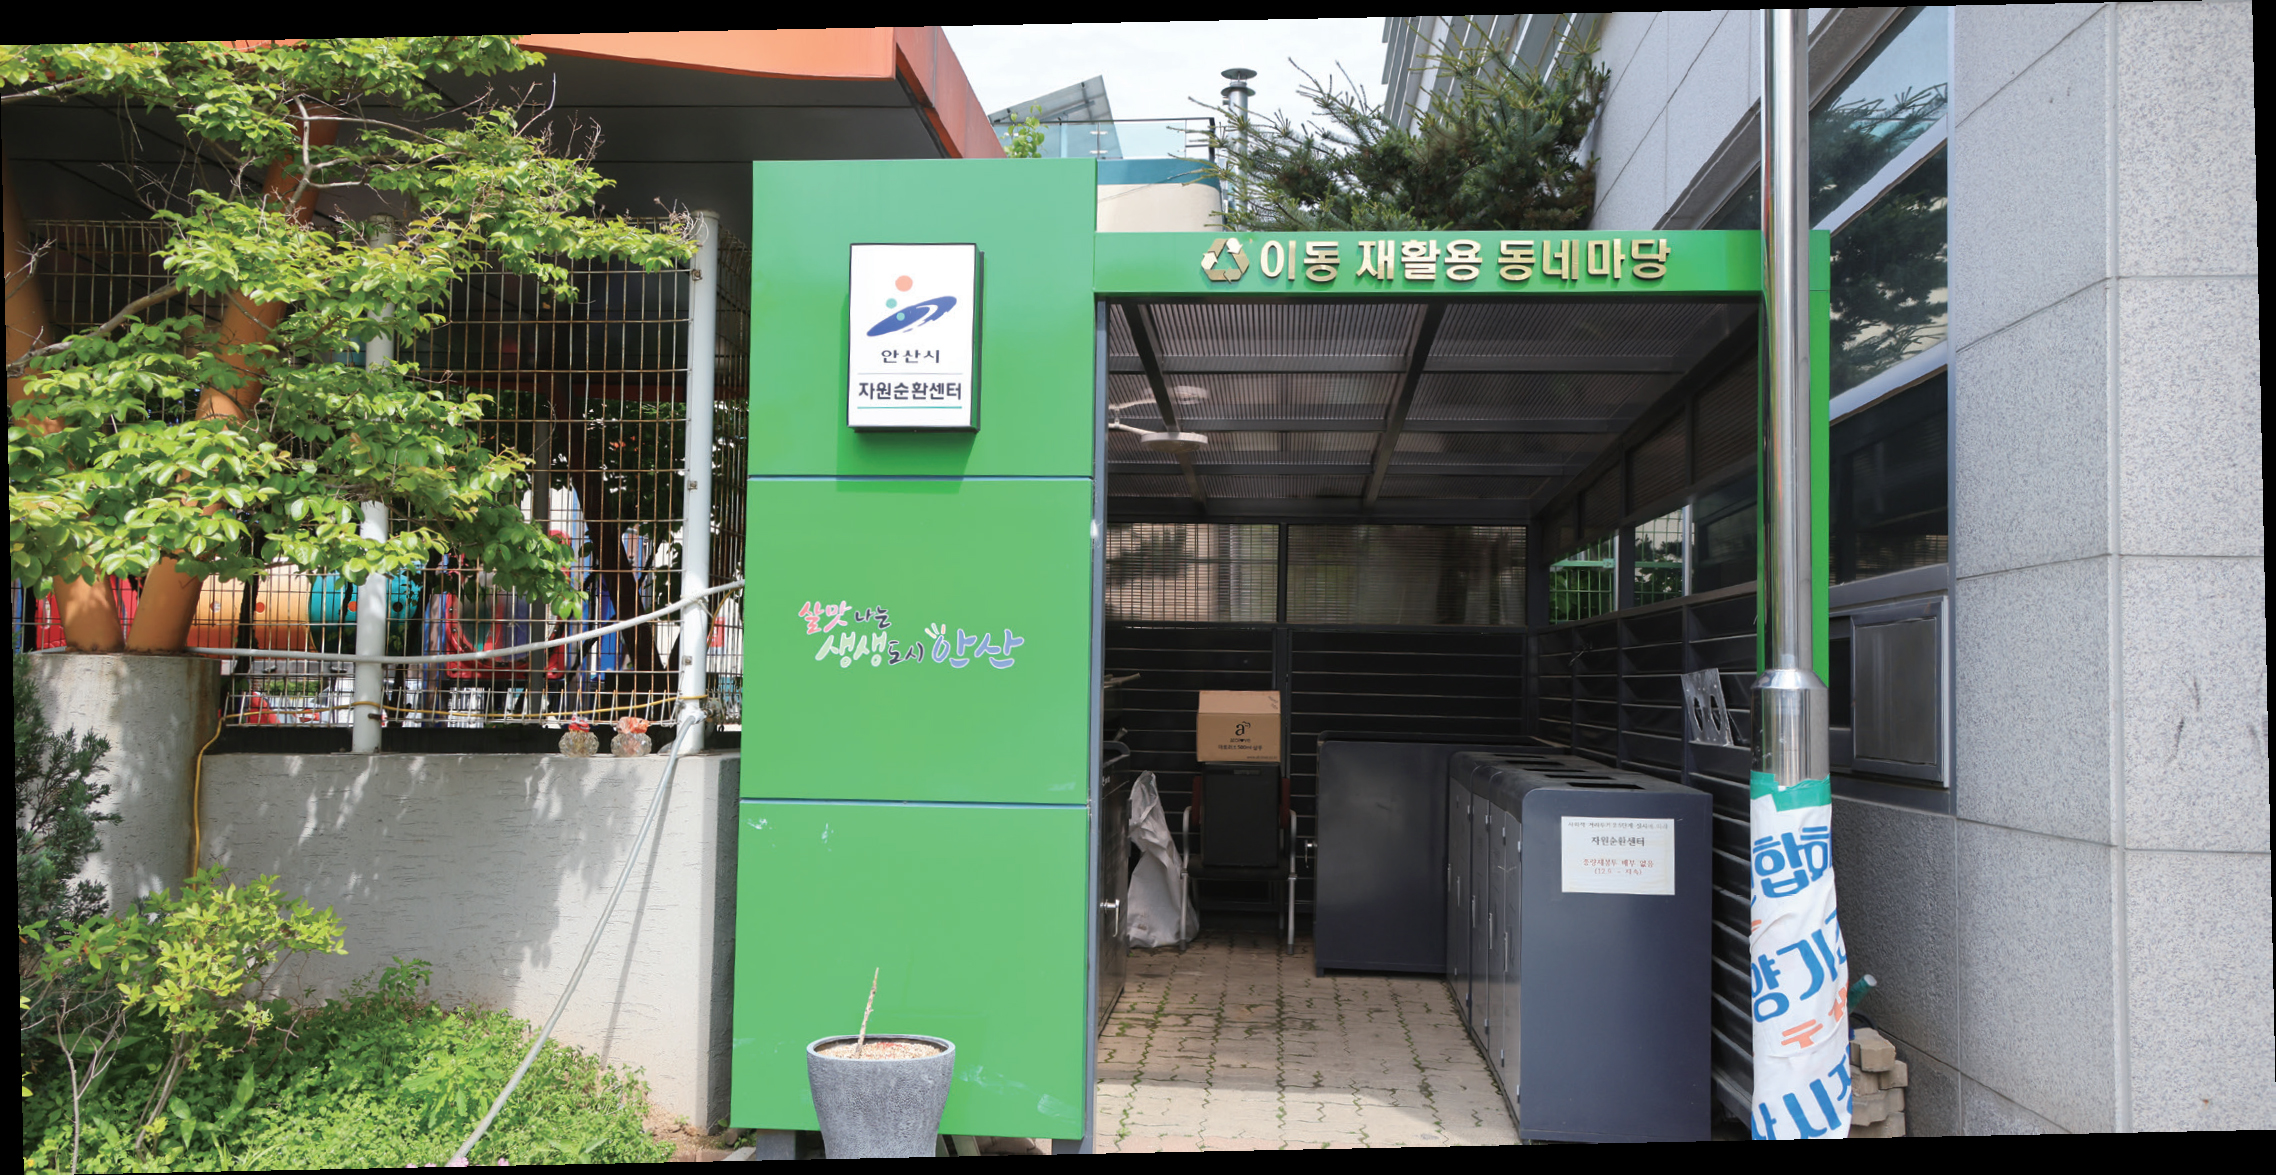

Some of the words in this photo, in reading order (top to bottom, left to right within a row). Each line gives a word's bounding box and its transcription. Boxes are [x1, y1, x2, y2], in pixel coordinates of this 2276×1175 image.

[1259, 239, 1340, 283] 이동
[1356, 239, 1483, 282] 재활용
[1498, 238, 1671, 282] 동네마당
[881, 349, 940, 364] 안산시
[858, 381, 962, 400] 자원순환센터
[931, 625, 1025, 669] 안산
[1591, 836, 1645, 847] 자원순환센터
